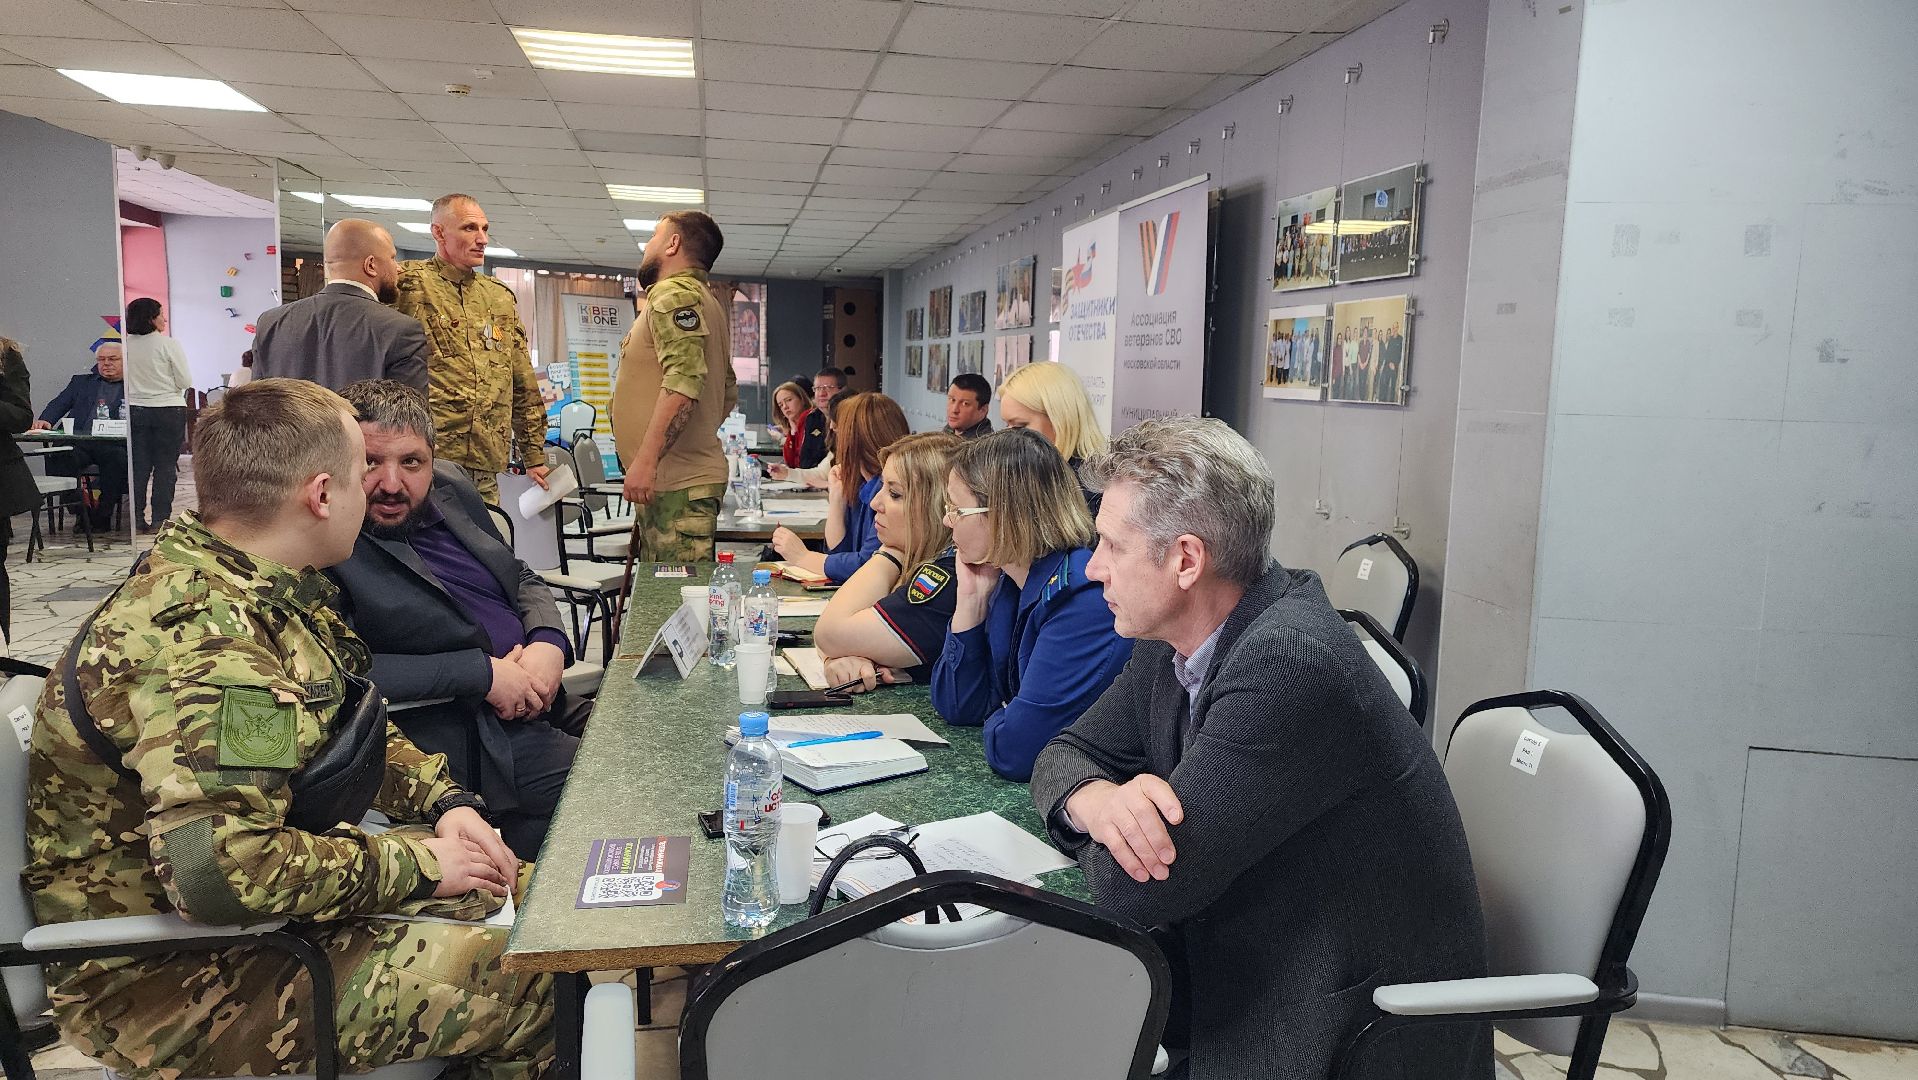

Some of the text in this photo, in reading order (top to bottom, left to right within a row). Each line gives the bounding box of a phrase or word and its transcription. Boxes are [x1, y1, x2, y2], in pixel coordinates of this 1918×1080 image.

[1070, 297, 1116, 320] ЗАЩИТНИКИ
[1130, 310, 1177, 328] Ассоциация
[593, 315, 619, 326] ONE
[1068, 320, 1107, 341] ОТЕЧЕСТВА
[1124, 327, 1182, 352] ветеранов СВО
